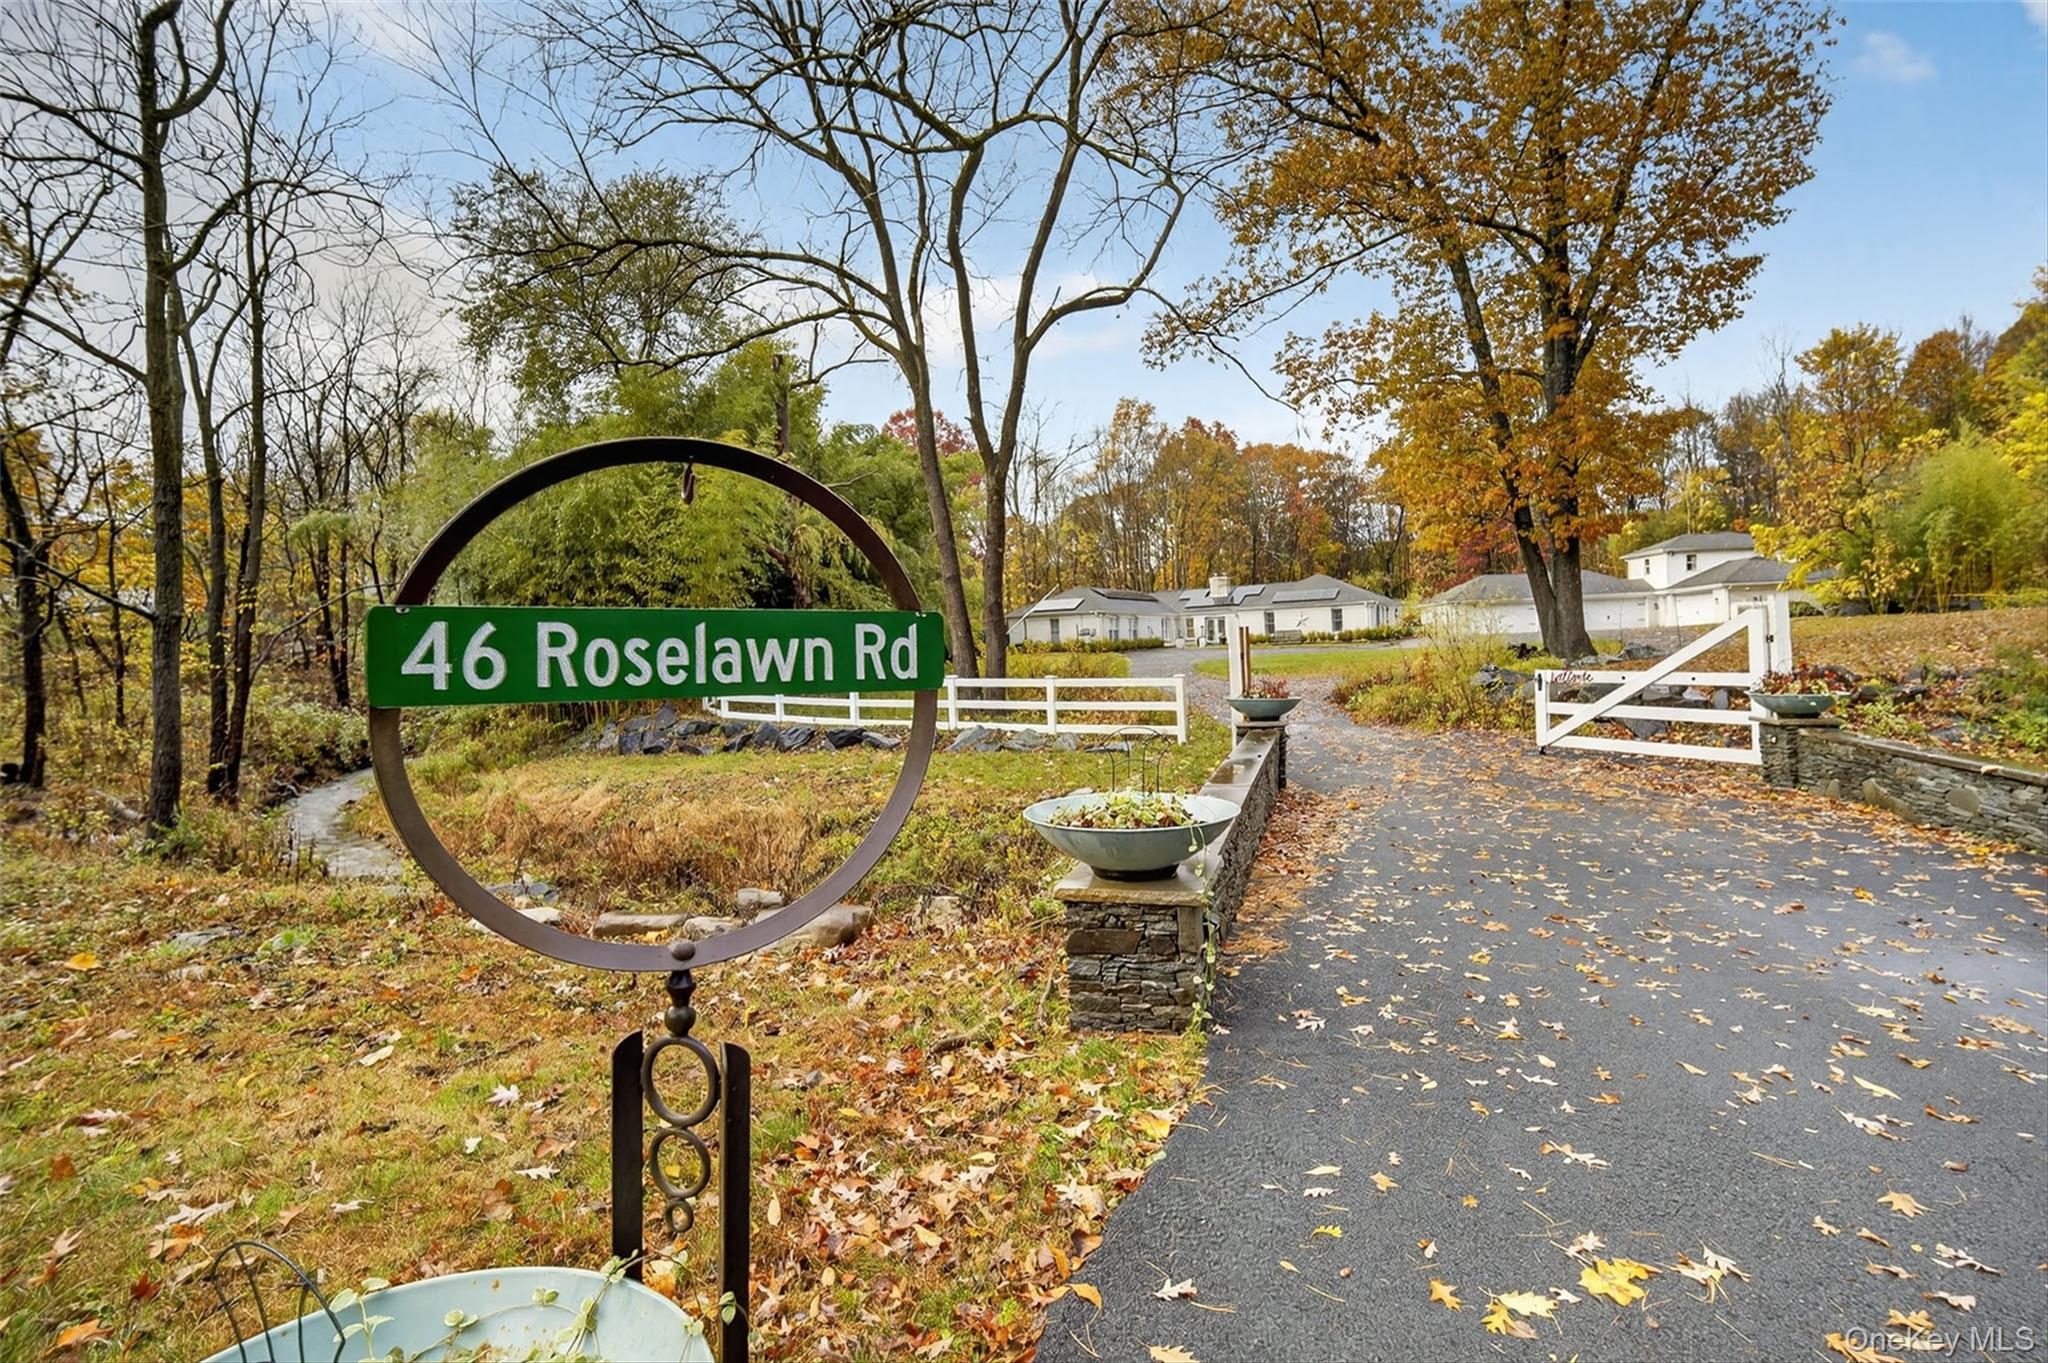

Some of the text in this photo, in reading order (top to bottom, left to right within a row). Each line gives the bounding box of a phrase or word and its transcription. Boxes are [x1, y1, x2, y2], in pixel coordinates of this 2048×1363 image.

[401, 621, 919, 690] 46 Roselawn Rd
